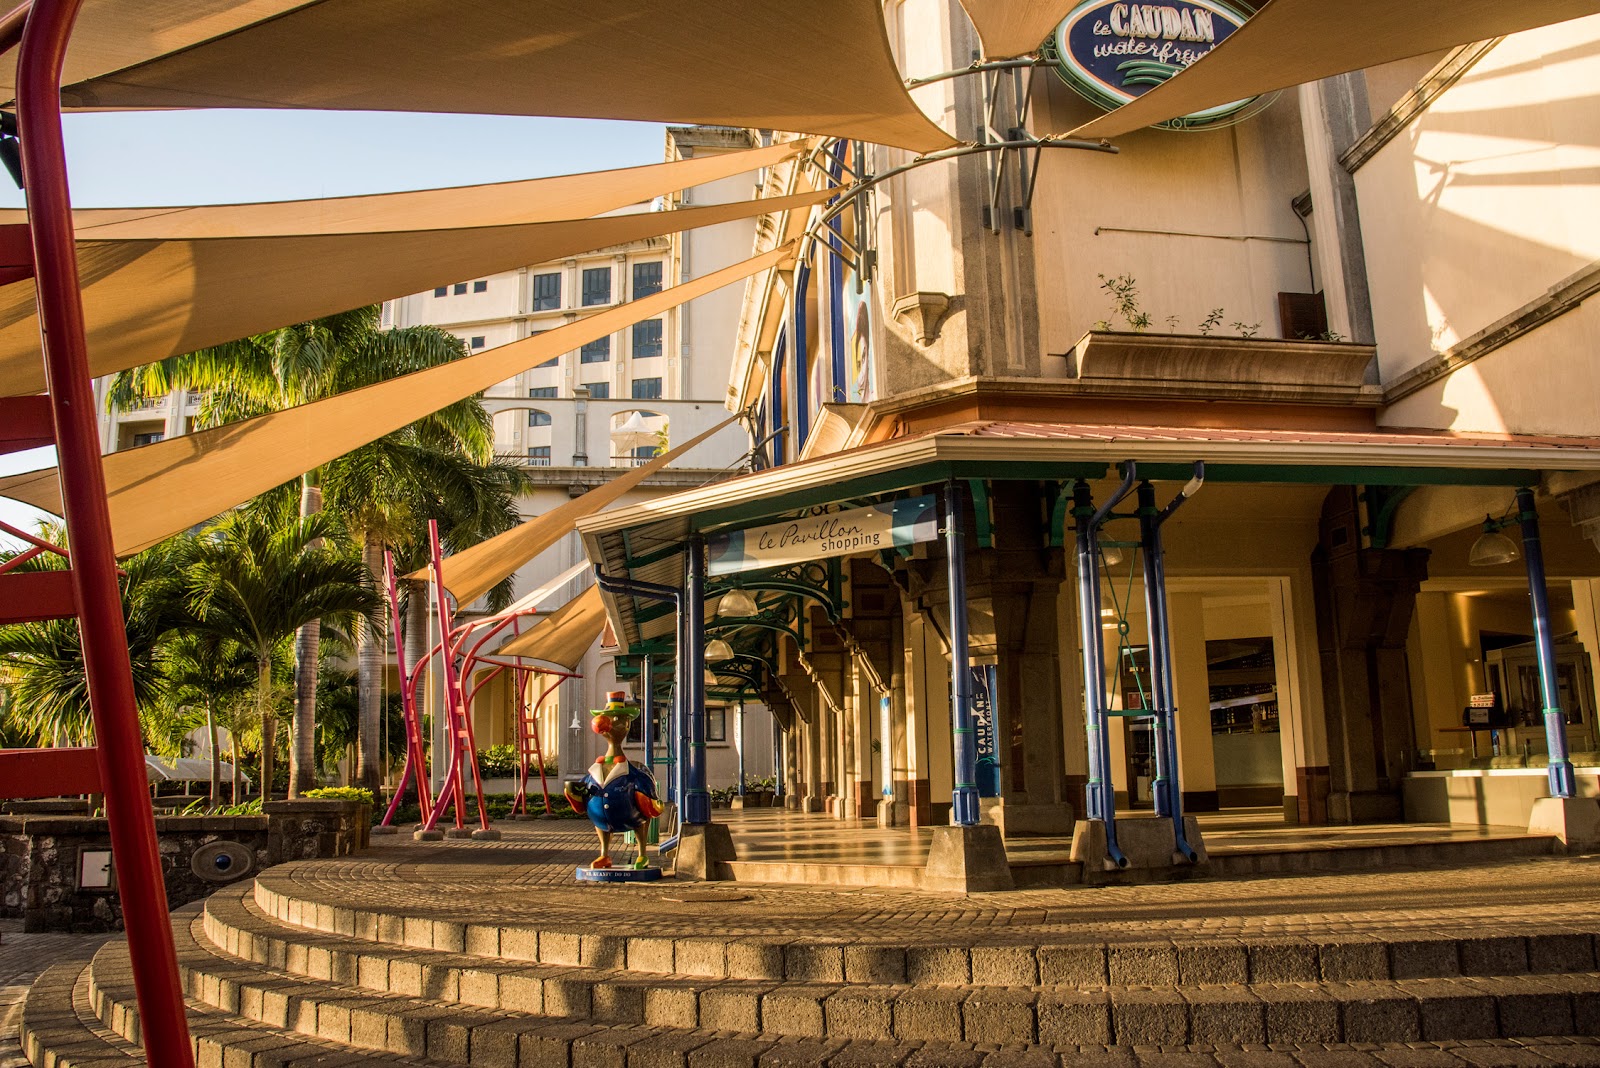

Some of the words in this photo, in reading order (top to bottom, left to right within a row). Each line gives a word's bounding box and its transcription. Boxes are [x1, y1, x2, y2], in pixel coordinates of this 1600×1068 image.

[1092, 20, 1112, 36] le
[1109, 2, 1215, 42] CAUDAN
[758, 531, 777, 550] le
[780, 518, 863, 548] Pavillon
[821, 533, 880, 552] shopping
[976, 700, 987, 754] CAUDAN
